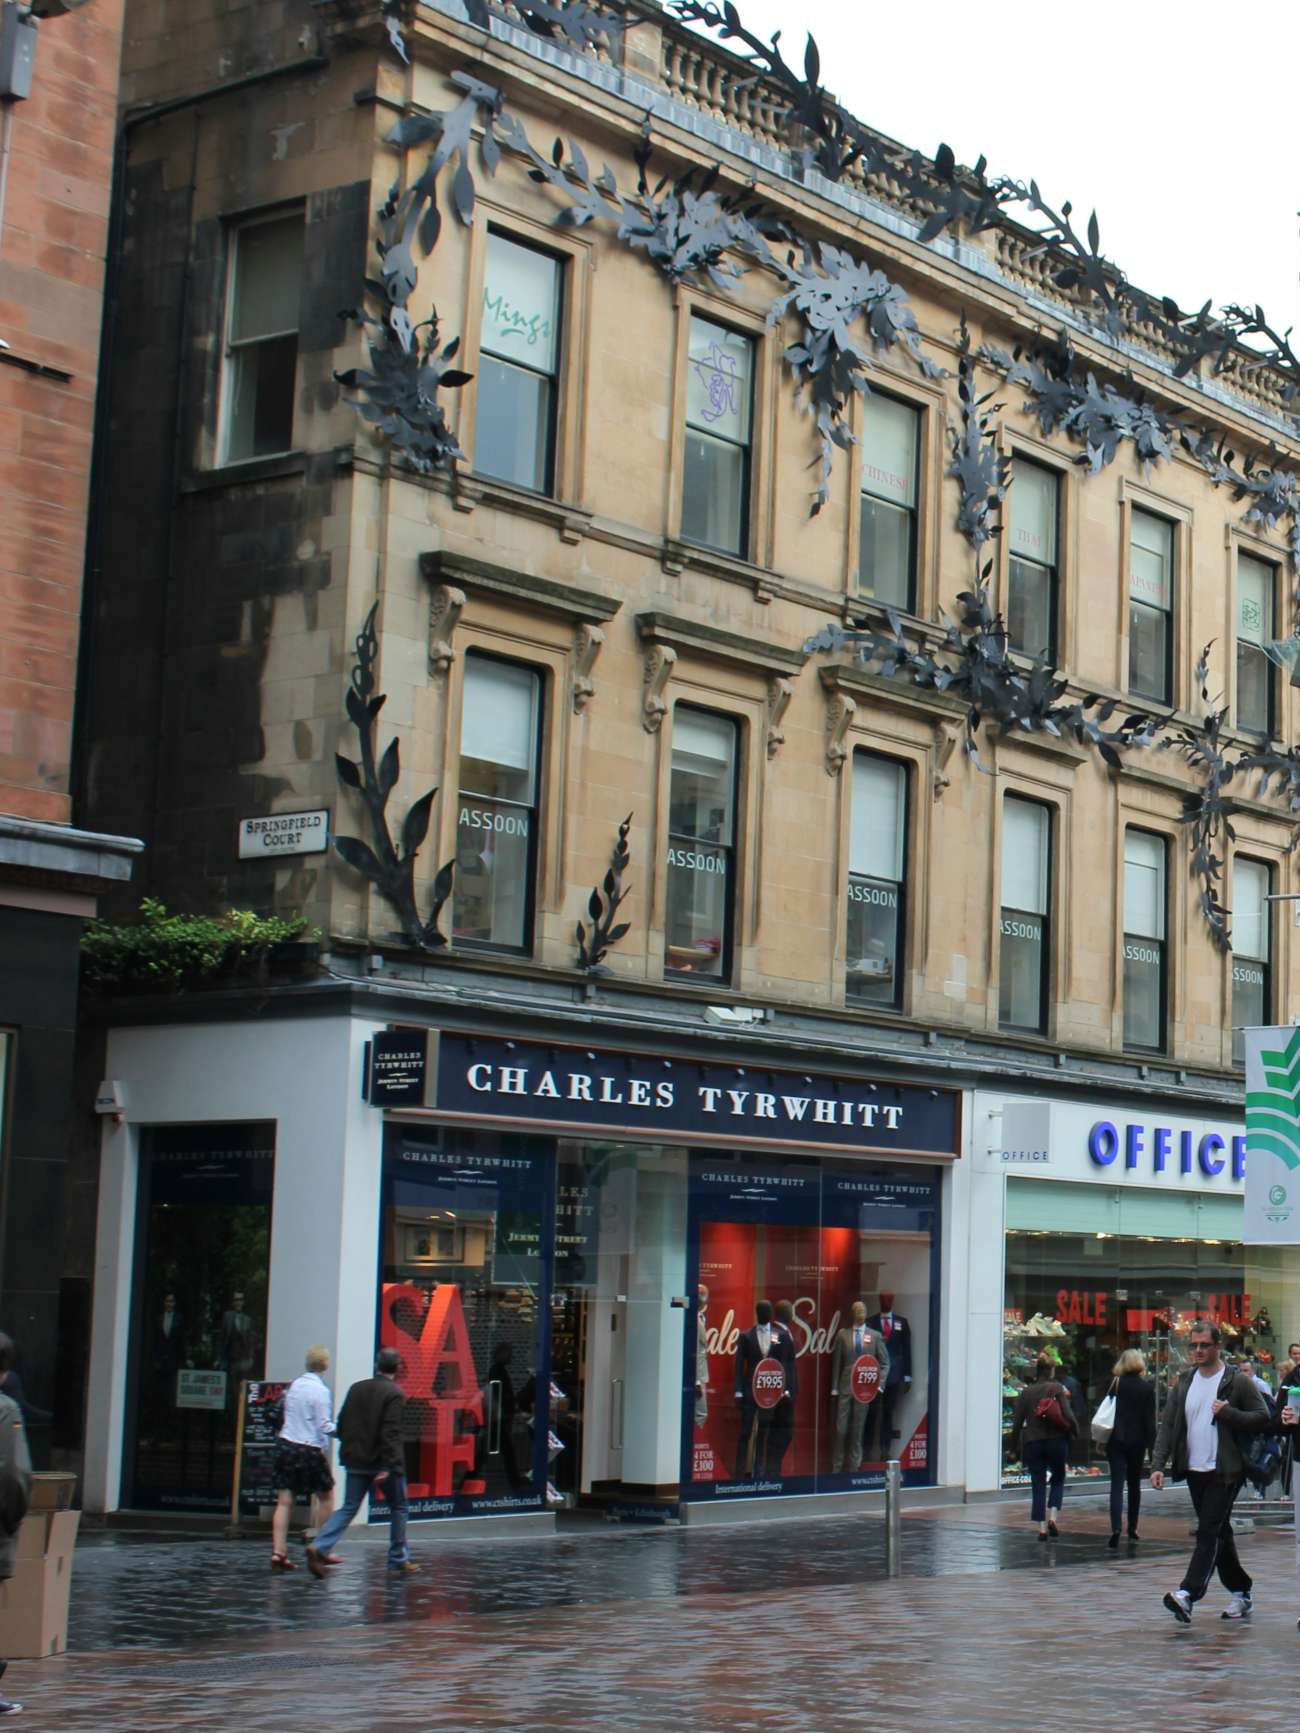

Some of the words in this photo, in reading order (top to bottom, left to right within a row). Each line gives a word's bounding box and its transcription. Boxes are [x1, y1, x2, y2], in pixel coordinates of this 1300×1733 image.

[246, 816, 321, 834] SPRINGFIELD
[263, 832, 302, 846] COURT
[378, 1052, 421, 1060] CHARLES
[375, 1061, 424, 1069] TYRWHITT
[466, 1063, 674, 1108] CHARLES
[698, 1086, 903, 1129] TYRWHITT
[1002, 1151, 1048, 1161] OFFICE
[1088, 1120, 1246, 1179] OFFICE
[402, 1151, 462, 1165] CHARLES
[466, 1156, 532, 1169] TYRWHITT
[702, 1173, 749, 1183] CHARLES
[752, 1176, 805, 1187] TYRWHITT
[837, 1181, 881, 1192] CHARLES
[883, 1184, 931, 1195] TYRWHITT
[1056, 1288, 1107, 1326] SALE
[1206, 1292, 1252, 1326] SALE
[792, 1297, 841, 1358] Sal
[756, 1375, 783, 1389] £19.95
[857, 1371, 878, 1384] £199
[422, 1501, 455, 1513] delivery
